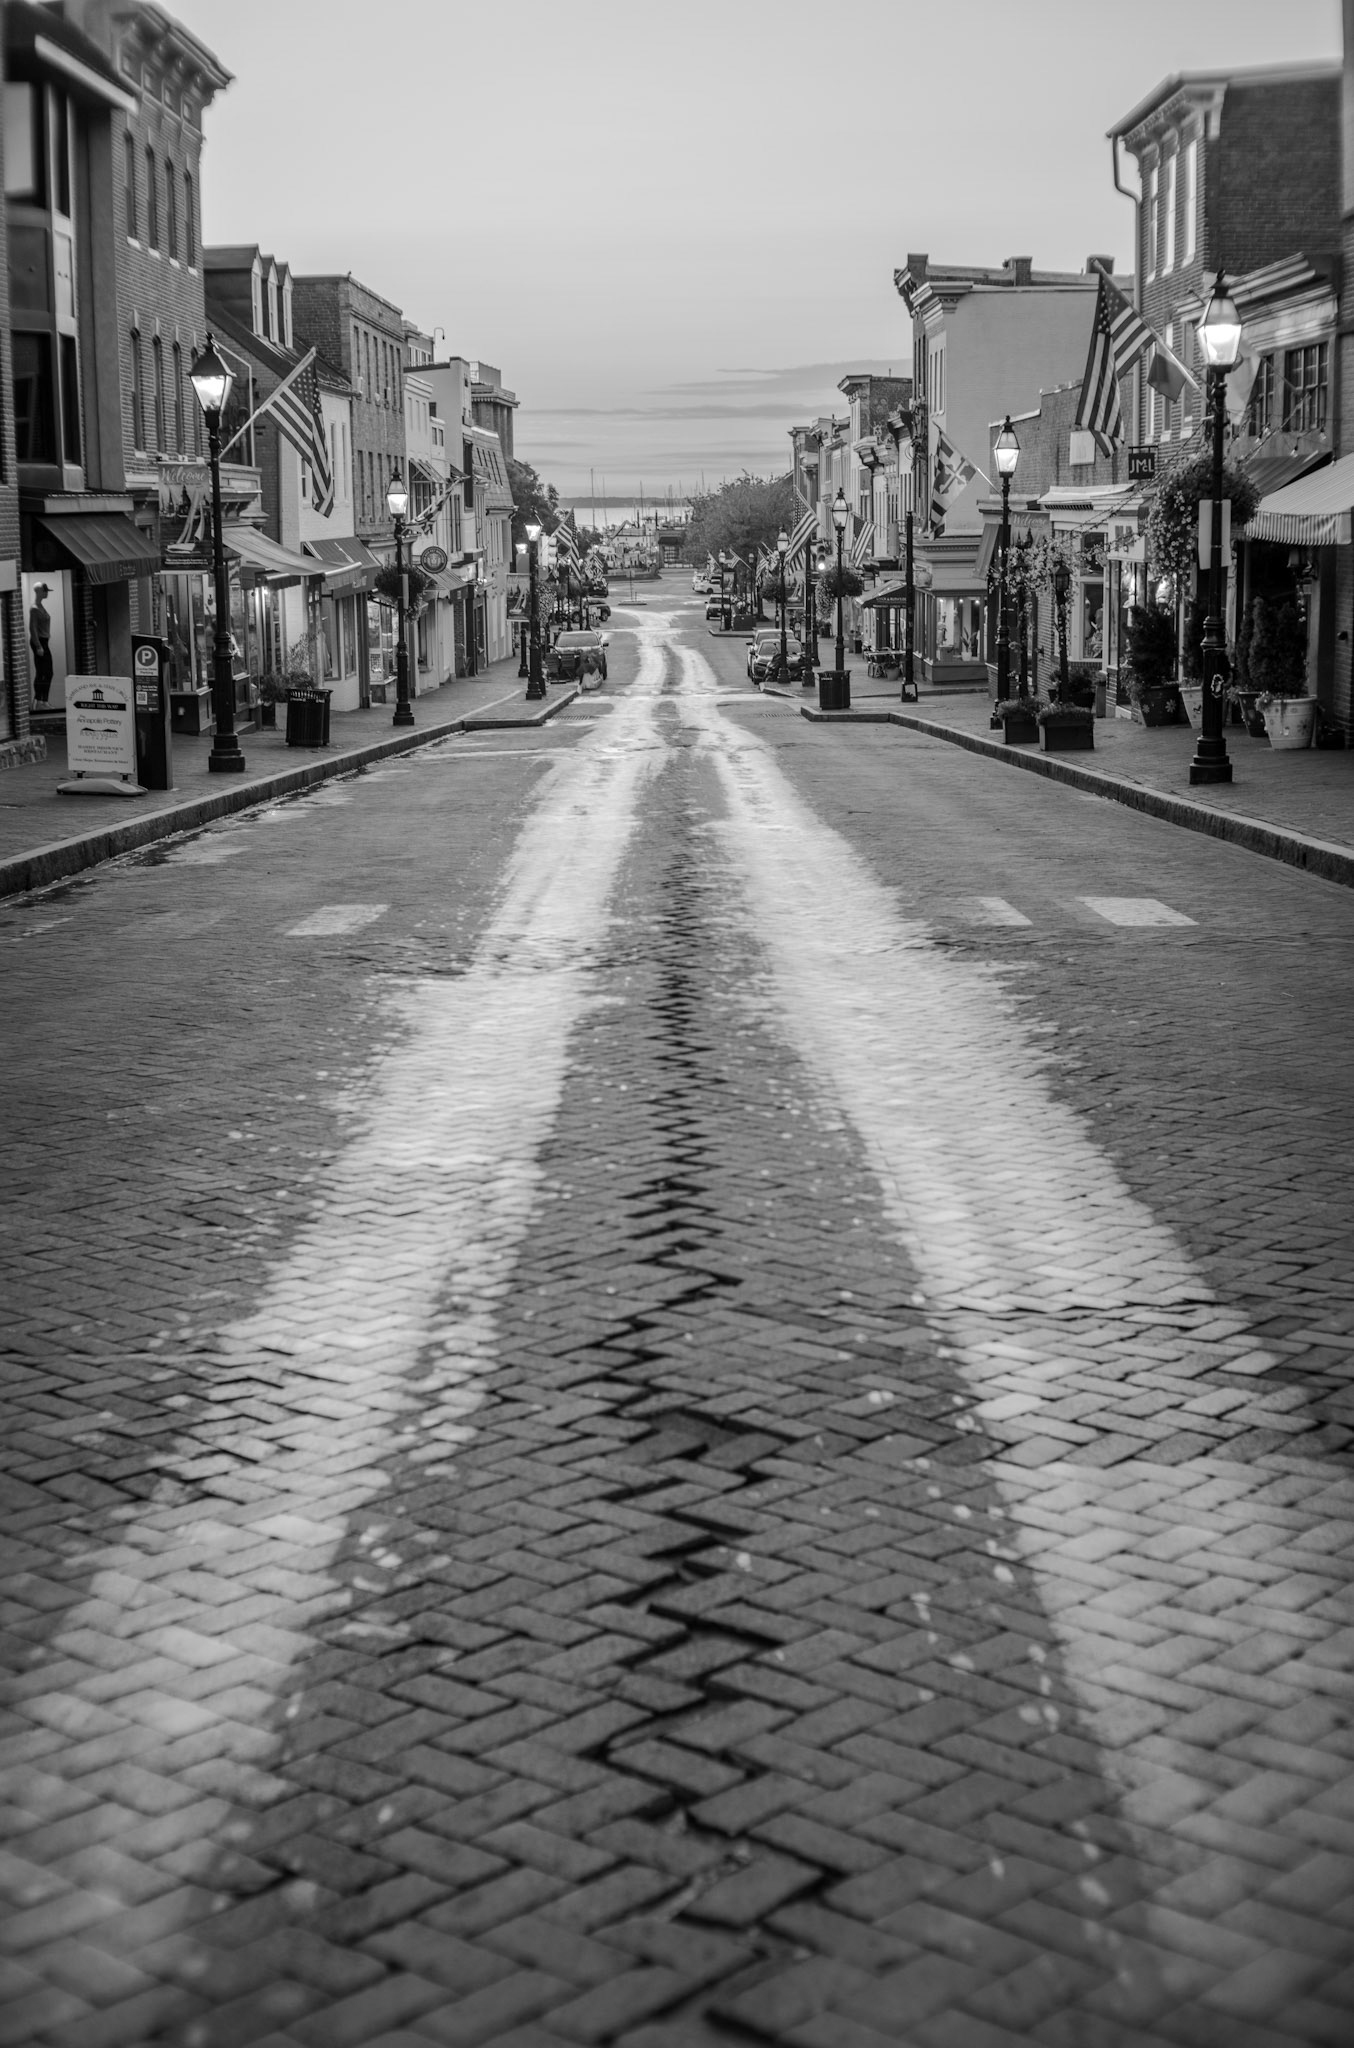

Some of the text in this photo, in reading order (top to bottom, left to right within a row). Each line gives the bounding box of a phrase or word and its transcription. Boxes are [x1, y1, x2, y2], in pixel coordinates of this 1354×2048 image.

[161, 465, 206, 483] Welcome
[1012, 513, 1047, 526] Welcome
[141, 650, 152, 664] P
[103, 718, 122, 726] Pottery
